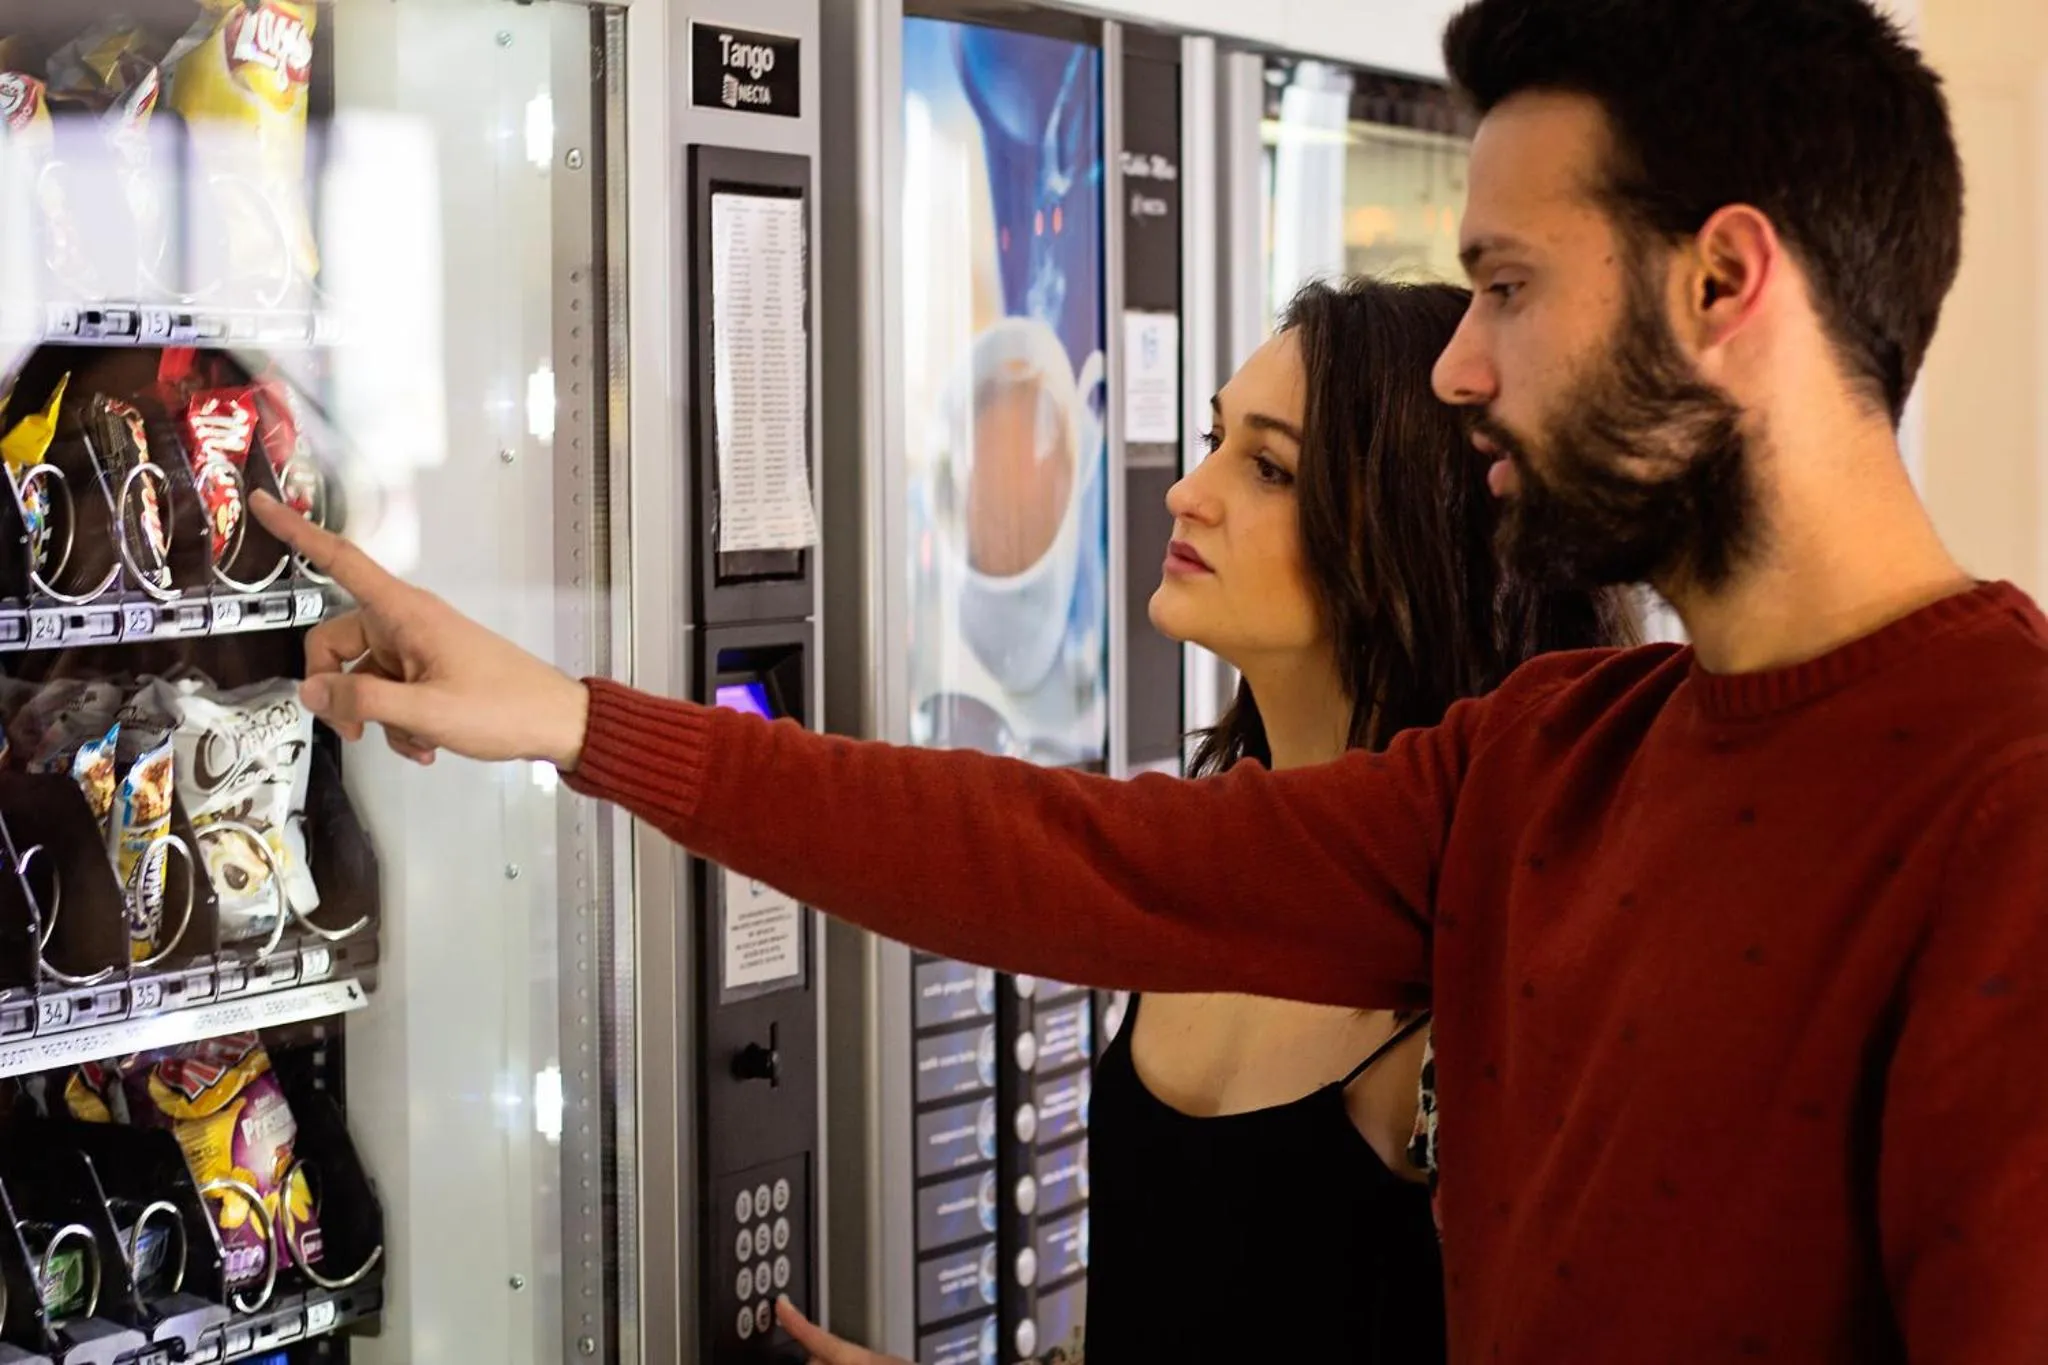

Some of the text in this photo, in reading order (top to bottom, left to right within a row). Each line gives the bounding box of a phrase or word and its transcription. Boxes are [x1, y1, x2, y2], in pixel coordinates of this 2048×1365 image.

[718, 34, 775, 79] Tango
[738, 84, 771, 104] NECTA
[36, 618, 55, 640] 24
[130, 611, 148, 634] 25
[136, 986, 156, 1008] 35
[43, 1003, 63, 1025] 34
